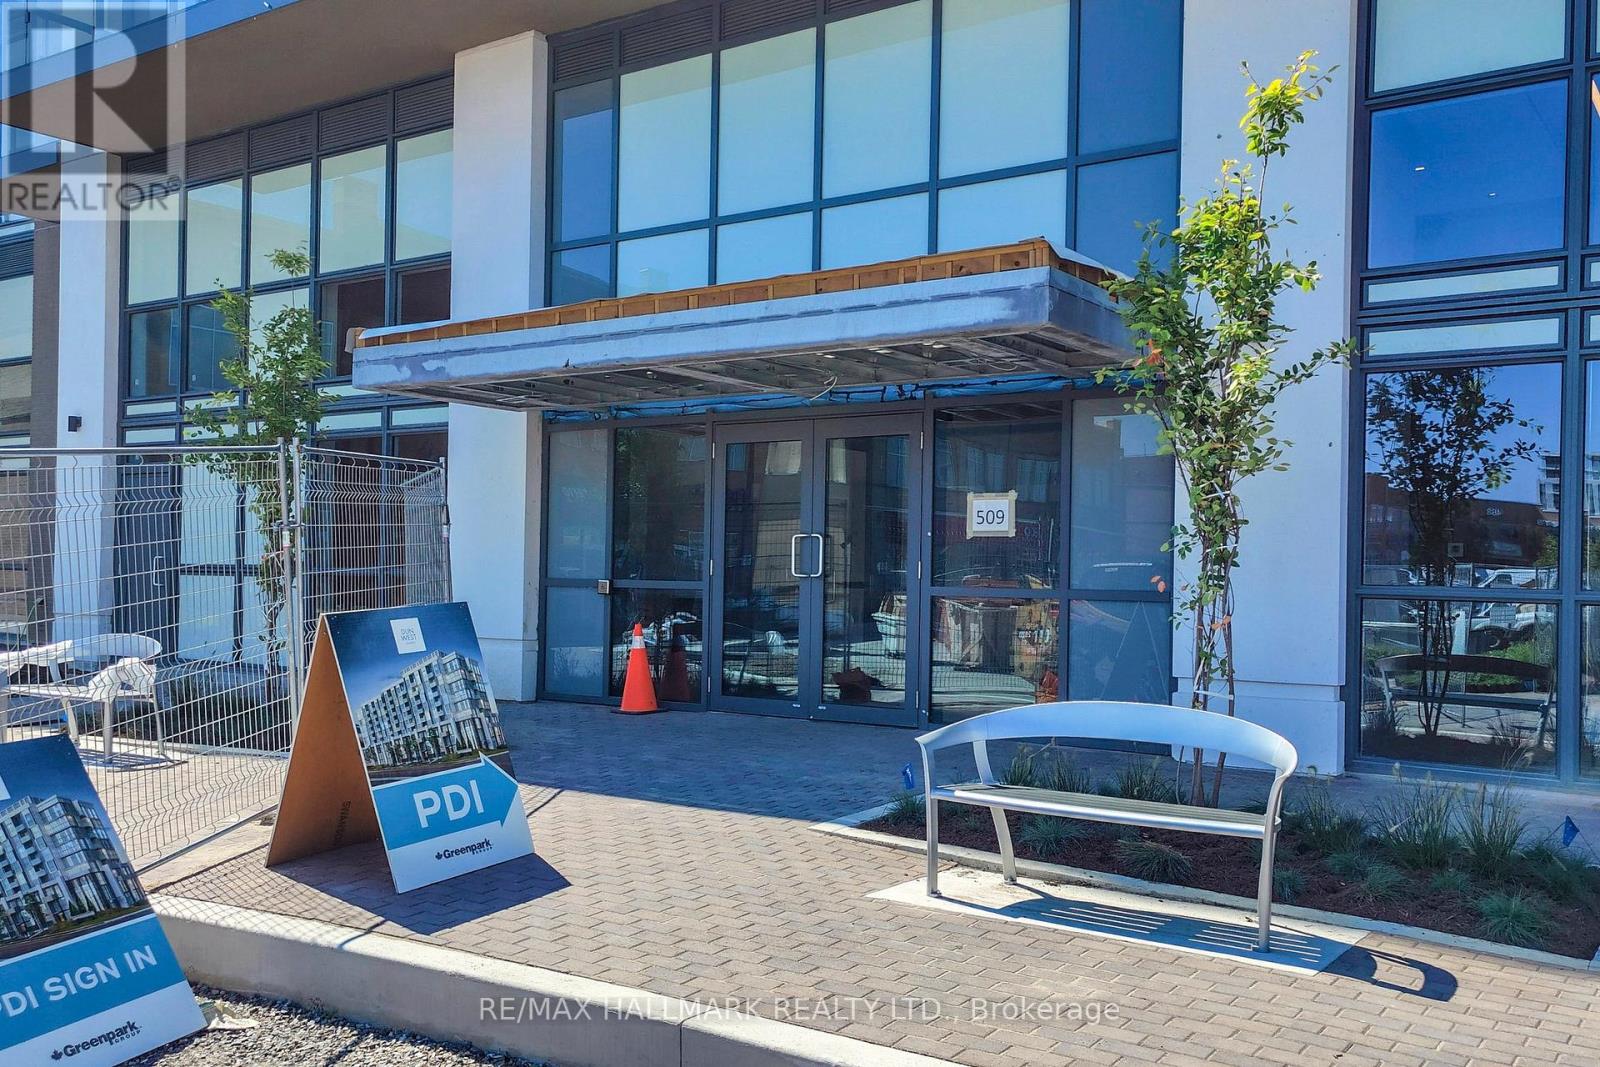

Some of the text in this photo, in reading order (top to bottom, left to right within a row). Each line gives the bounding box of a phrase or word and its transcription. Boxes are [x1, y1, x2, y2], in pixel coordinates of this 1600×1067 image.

[976, 509, 1005, 525] 509
[413, 779, 484, 829] PDI
[443, 838, 492, 859] Greenpark
[0, 945, 158, 1017] DI SIGN IN
[63, 1020, 139, 1058] Greenpark
